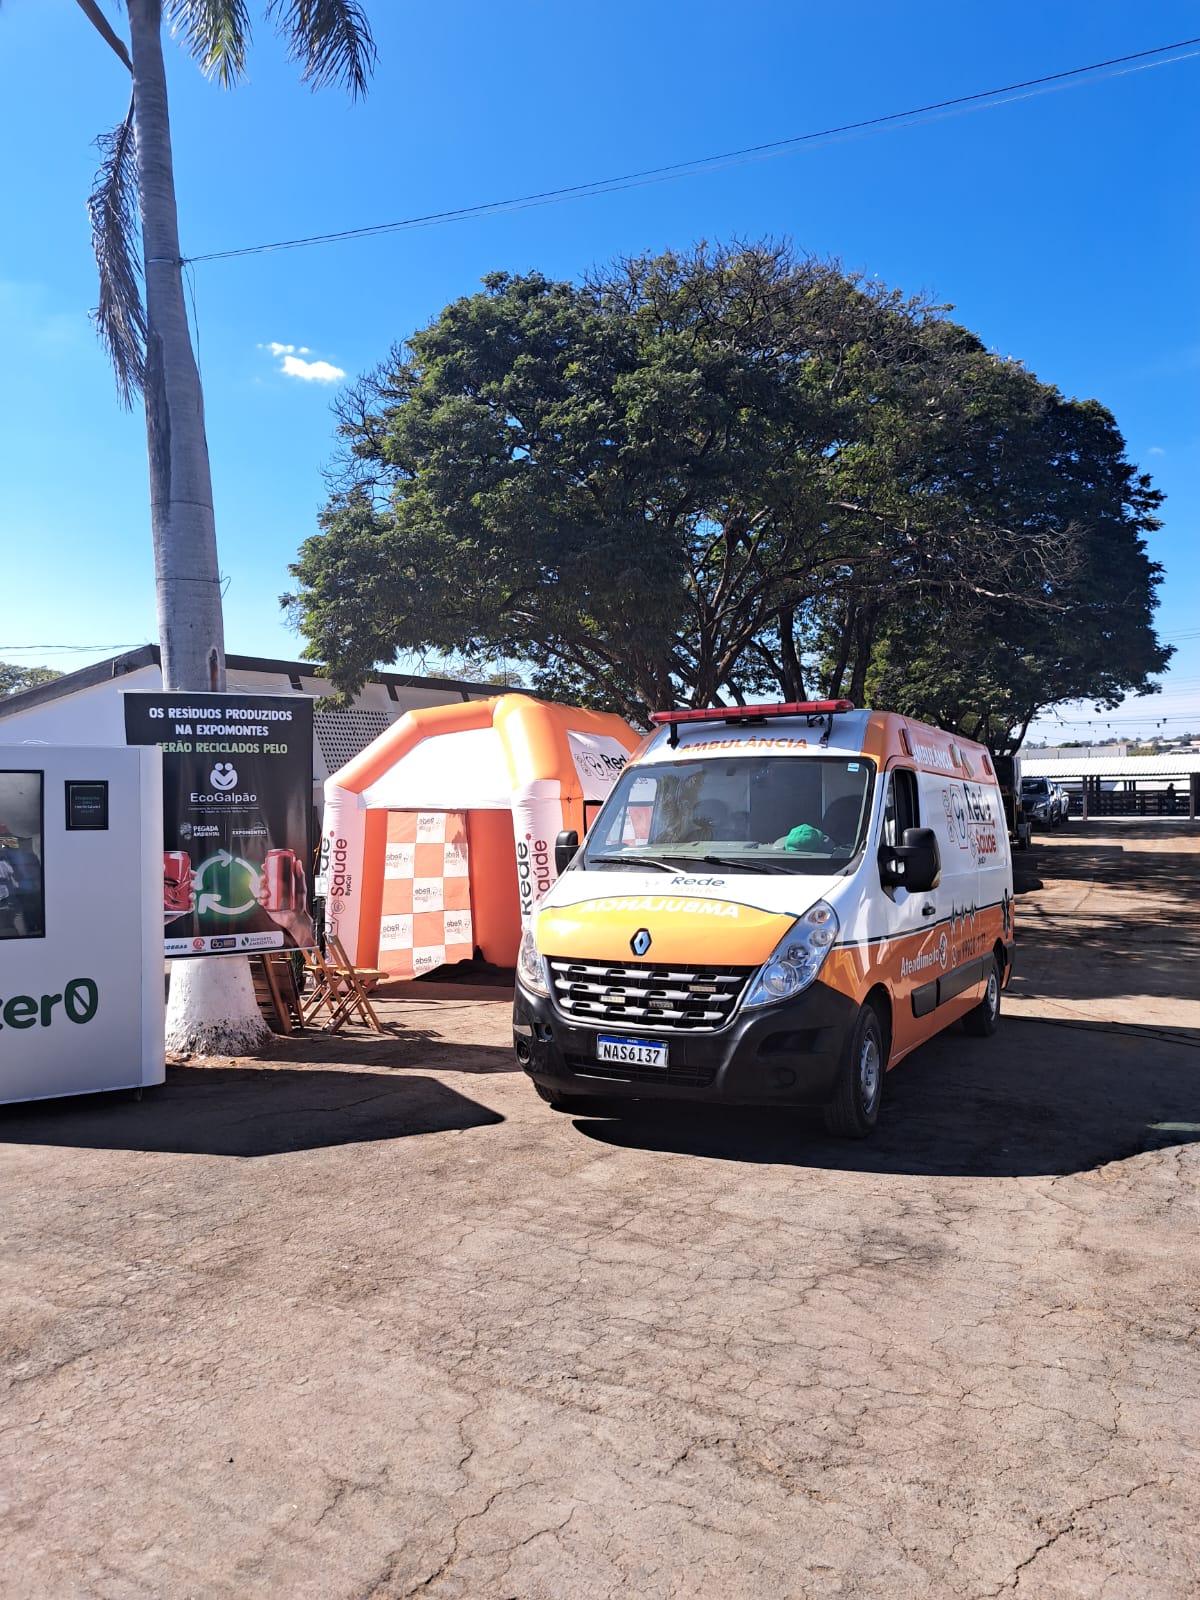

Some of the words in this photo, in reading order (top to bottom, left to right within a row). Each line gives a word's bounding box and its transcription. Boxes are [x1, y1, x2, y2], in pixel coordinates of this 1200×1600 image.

[149, 707, 165, 719] OS
[168, 706, 222, 719] RESÍDUOS
[225, 709, 293, 721] PRODUZIDOS
[175, 724, 192, 735] NA
[196, 725, 269, 736] EXPOMONTES
[196, 742, 260, 754] RECICLADOS
[263, 743, 288, 754] PELO
[679, 735, 808, 753] AMBULÂNCIA
[600, 754, 628, 770] Red
[190, 792, 257, 804] EcoGalpão
[331, 838, 347, 897] Saúde
[533, 840, 551, 900] aúde
[518, 842, 532, 915] Rede
[671, 876, 725, 887] Rede
[901, 946, 940, 977] Atendimeto
[0, 977, 99, 1030] er0
[603, 1043, 661, 1064] NAS6137
